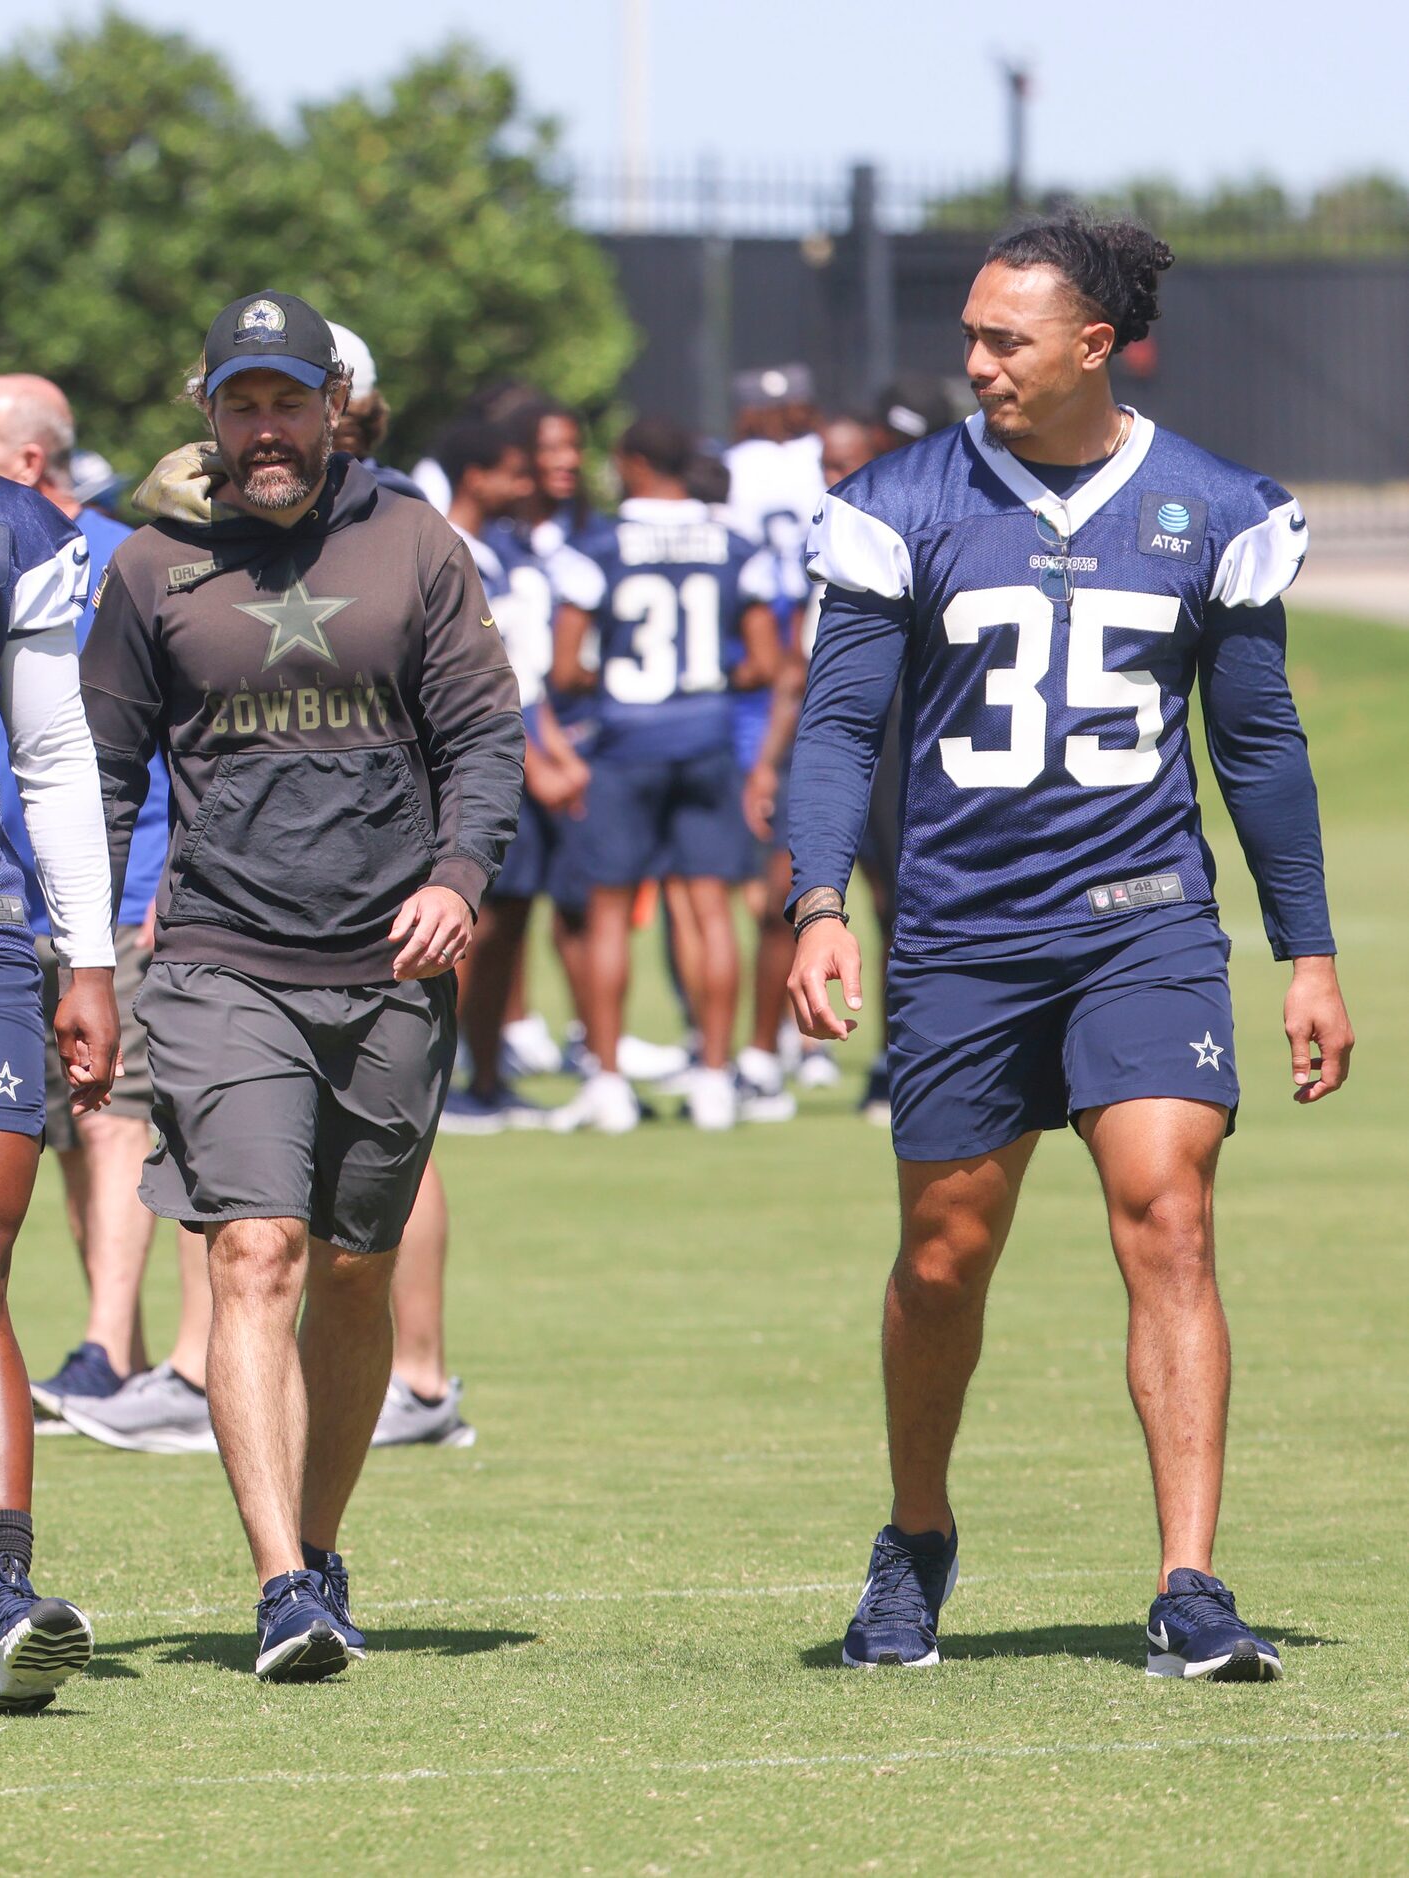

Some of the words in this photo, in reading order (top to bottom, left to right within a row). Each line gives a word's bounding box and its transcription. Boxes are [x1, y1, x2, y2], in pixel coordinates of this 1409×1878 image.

[1150, 534, 1192, 554] AT&T
[604, 573, 728, 705] 31
[938, 584, 1183, 789] 35
